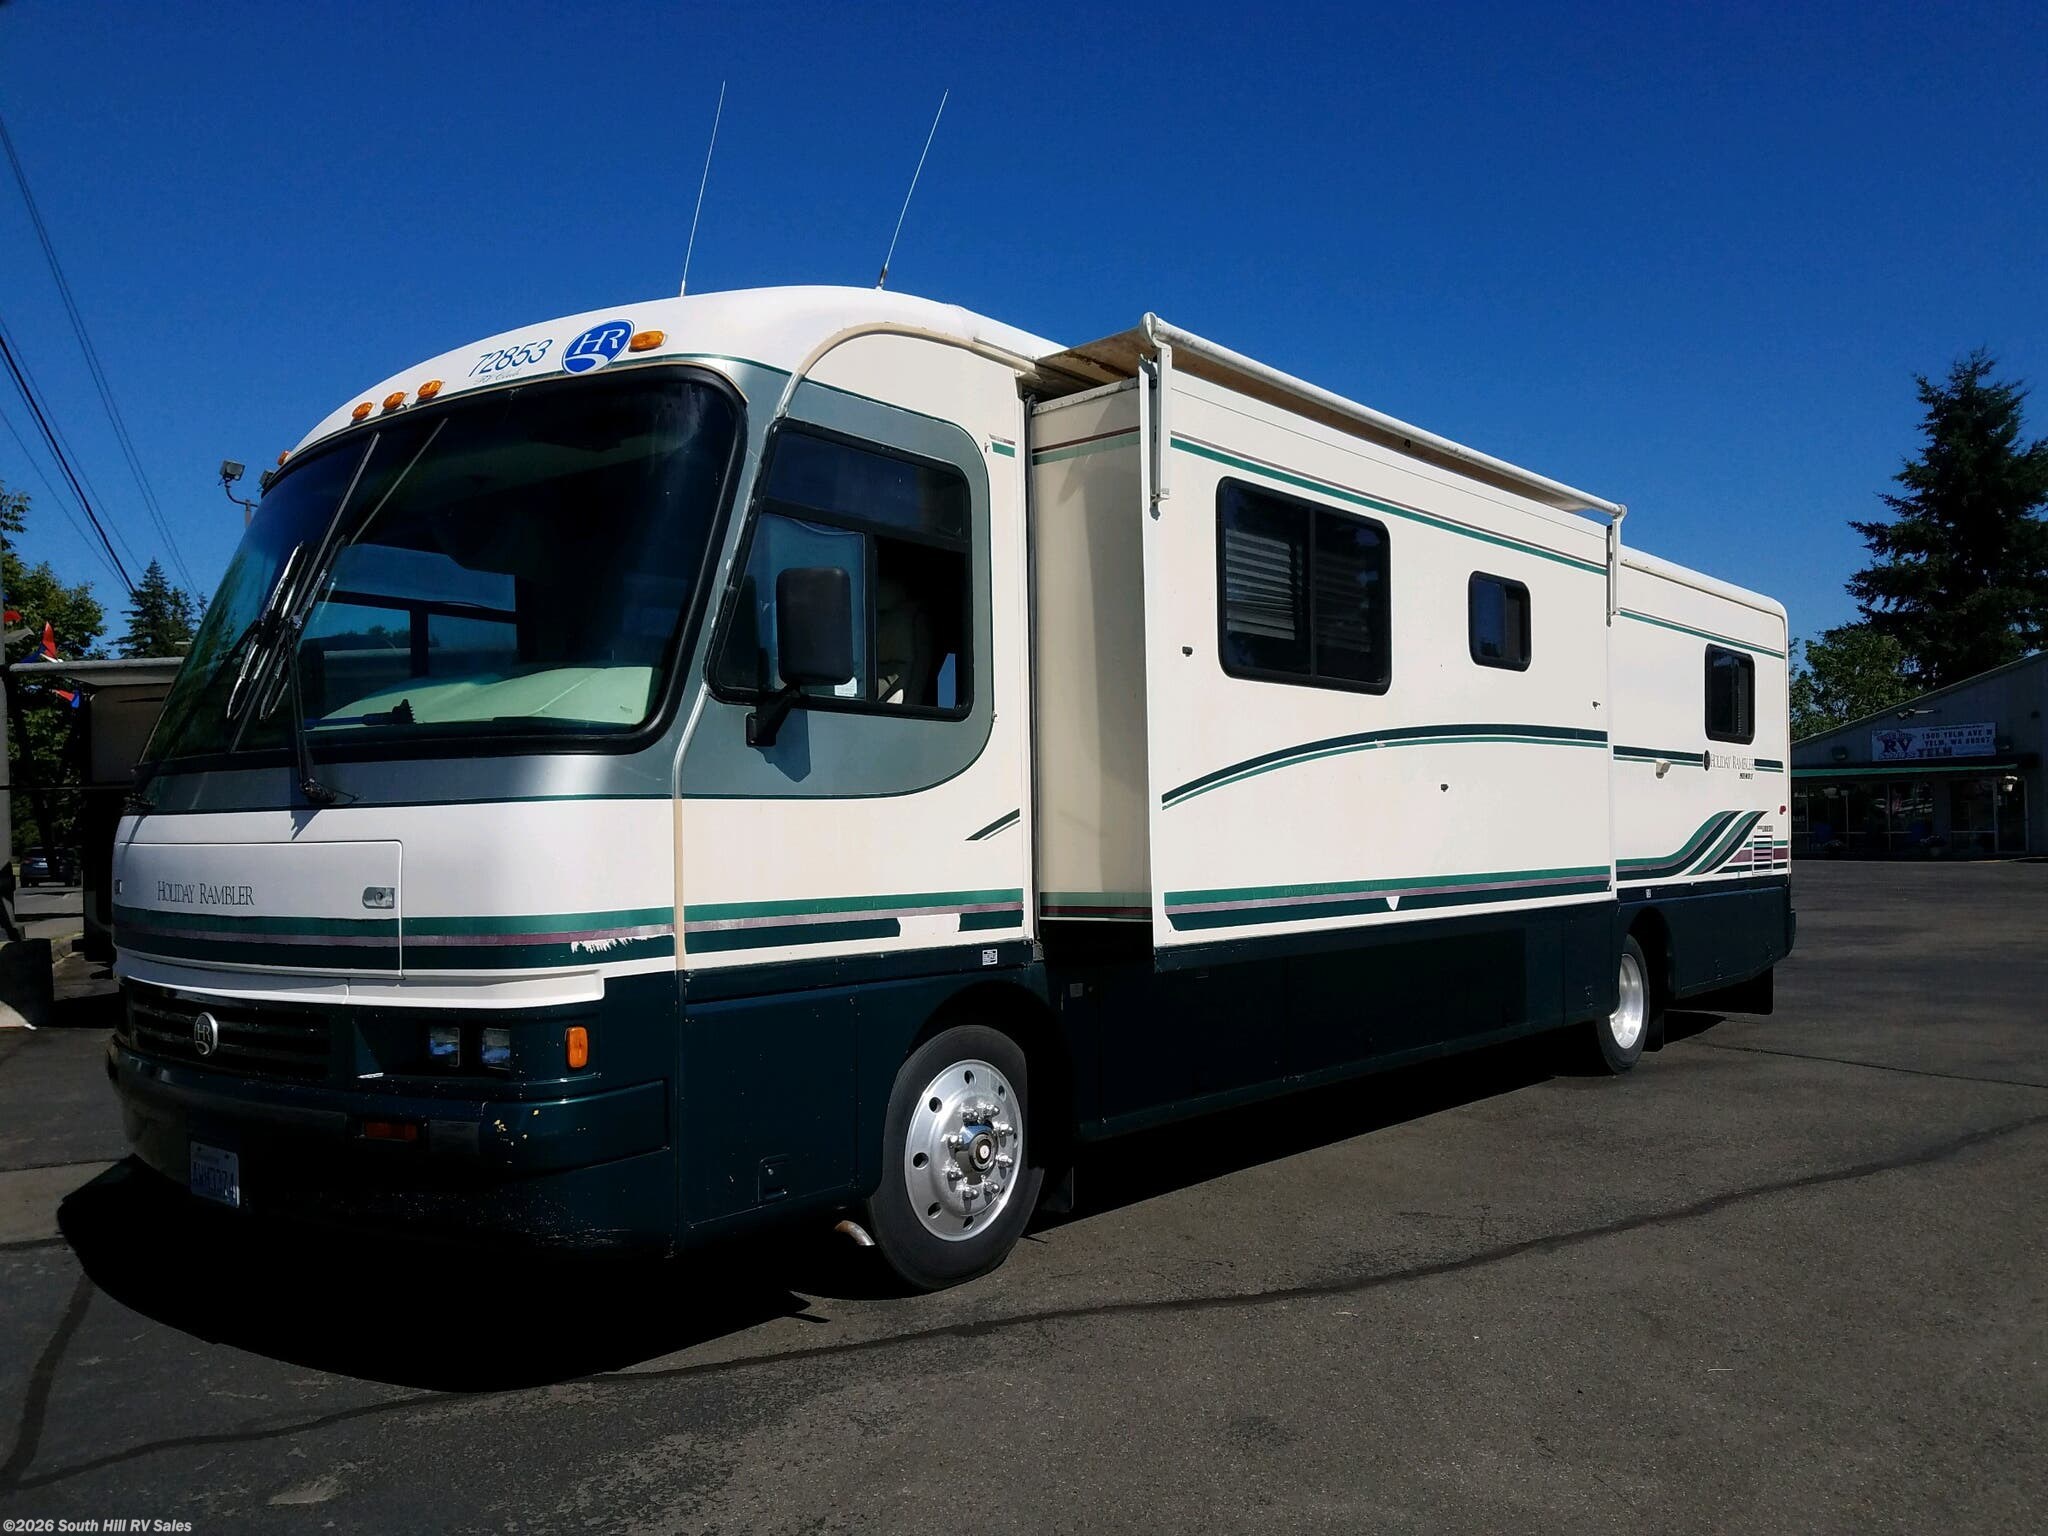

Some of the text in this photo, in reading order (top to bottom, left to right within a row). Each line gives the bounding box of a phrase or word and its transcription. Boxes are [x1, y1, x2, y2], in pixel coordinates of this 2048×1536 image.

[574, 328, 626, 356] HR
[468, 338, 554, 378] 72853
[157, 880, 255, 906] HOLIDAY RAMBLER
